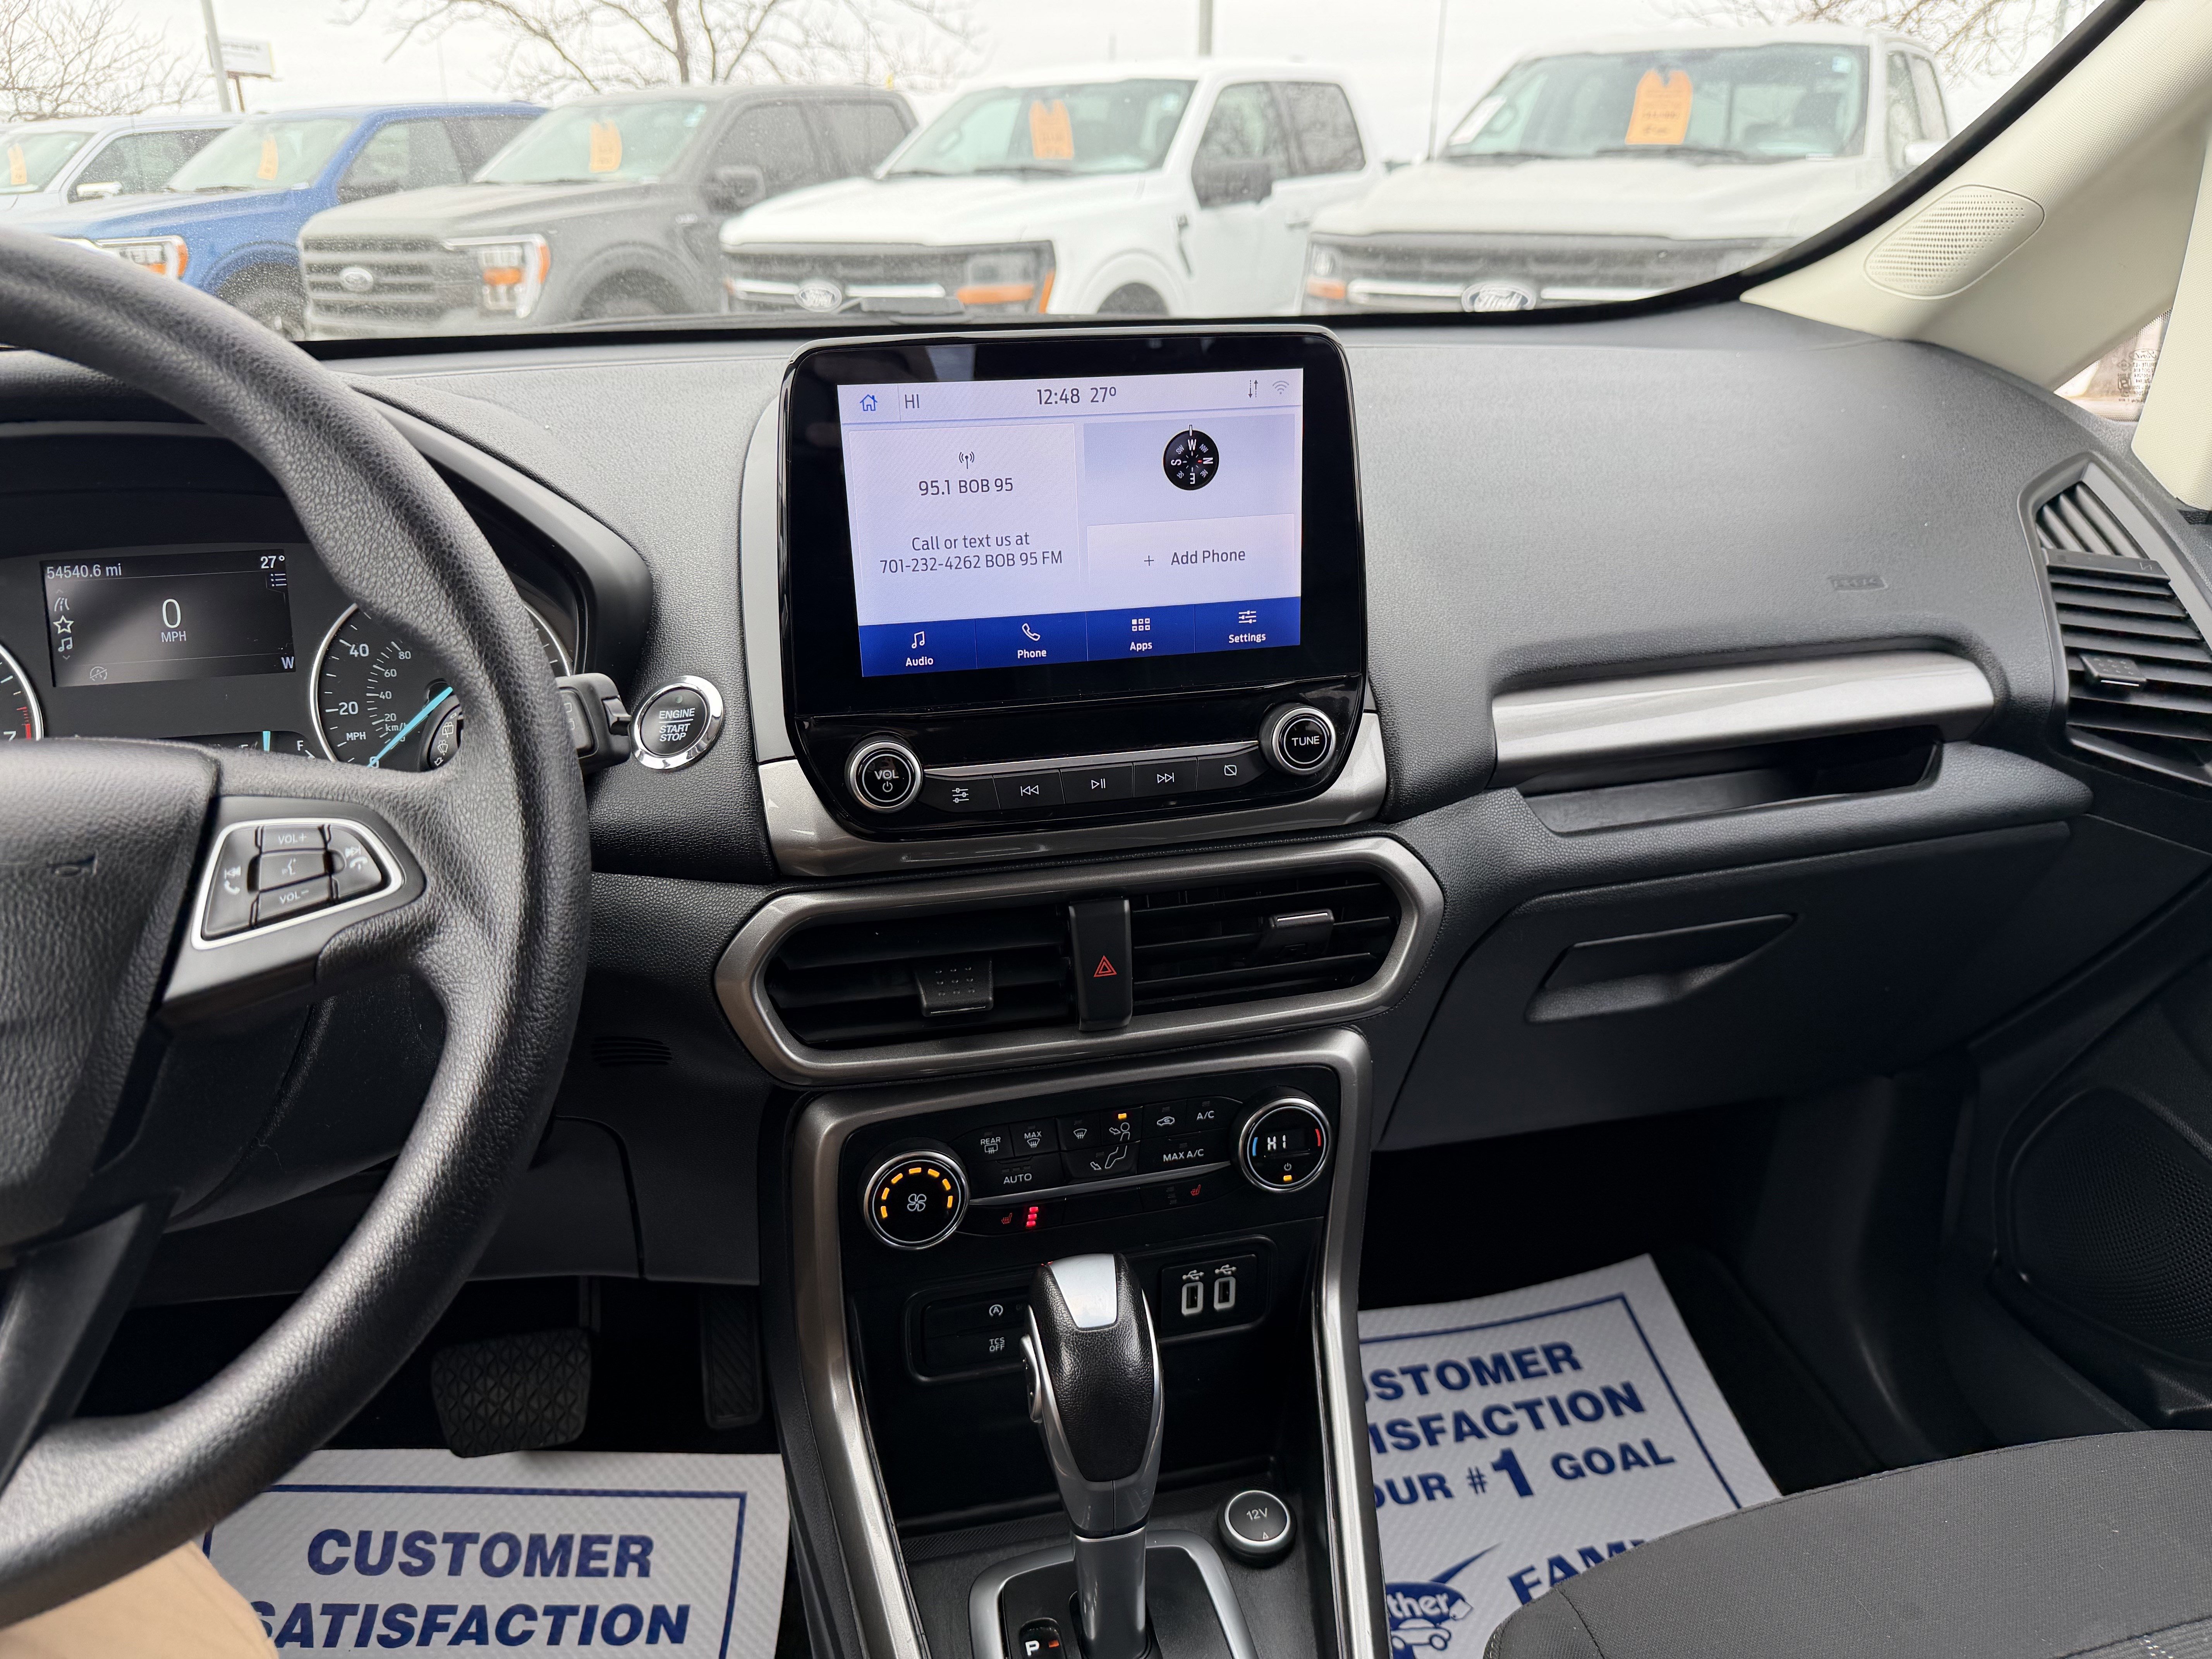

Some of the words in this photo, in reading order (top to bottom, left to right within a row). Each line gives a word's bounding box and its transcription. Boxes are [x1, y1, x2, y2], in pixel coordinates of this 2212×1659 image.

[905, 394, 920, 409] HI
[1037, 388, 1080, 405] 12:48
[1188, 439, 1197, 451] W
[1190, 473, 1195, 484] E
[919, 479, 950, 496] 95.1
[958, 479, 990, 494] BOB
[994, 477, 1013, 492] 95
[912, 536, 939, 551] Call
[944, 538, 958, 549] or
[963, 534, 991, 548] text
[996, 535, 1011, 546] us
[1015, 532, 1030, 545] at
[880, 555, 981, 574] 701-232-4262
[985, 553, 1015, 568] BOB
[1020, 552, 1037, 566] 95
[1042, 551, 1062, 565] FM
[1171, 551, 1197, 566] Add
[1202, 549, 1245, 563] Phone
[47, 564, 101, 579] 54540.6
[106, 563, 122, 577] mi
[163, 599, 181, 628] 0
[161, 631, 187, 643] MPH
[1228, 631, 1266, 644] Settings
[350, 644, 369, 657] 40
[1130, 641, 1153, 652] Apps
[399, 651, 411, 660] 80
[1017, 648, 1047, 659] Phone
[282, 656, 294, 670] W
[905, 656, 934, 667] Audio
[385, 669, 397, 677] 60
[380, 691, 392, 699] 40
[339, 701, 358, 715] 20
[659, 708, 695, 719] ENGINE
[385, 713, 397, 722] 20
[659, 723, 690, 733] START
[3, 731, 16, 742] 7
[346, 732, 366, 740] MPH
[659, 733, 686, 742] STOP
[1291, 735, 1320, 747] TUNE
[297, 740, 304, 751] F
[874, 769, 899, 780] VOL
[1196, 1110, 1214, 1120] A/C
[1024, 1130, 1042, 1139] MAX
[981, 1136, 1001, 1146] REAR
[1267, 1135, 1286, 1151] HI
[1163, 1151, 1184, 1162] MAX
[1186, 1148, 1204, 1159] A/C
[1003, 1173, 1032, 1185] AUTO
[989, 1337, 1005, 1345] TCS
[989, 1343, 1005, 1352] OFF
[1365, 1341, 1582, 1403] STOMER
[1550, 1438, 1676, 1480] GOAL
[1247, 1508, 1267, 1521] 12V
[308, 1528, 654, 1577] CUSTOMER
[1025, 1640, 1039, 1656] P
